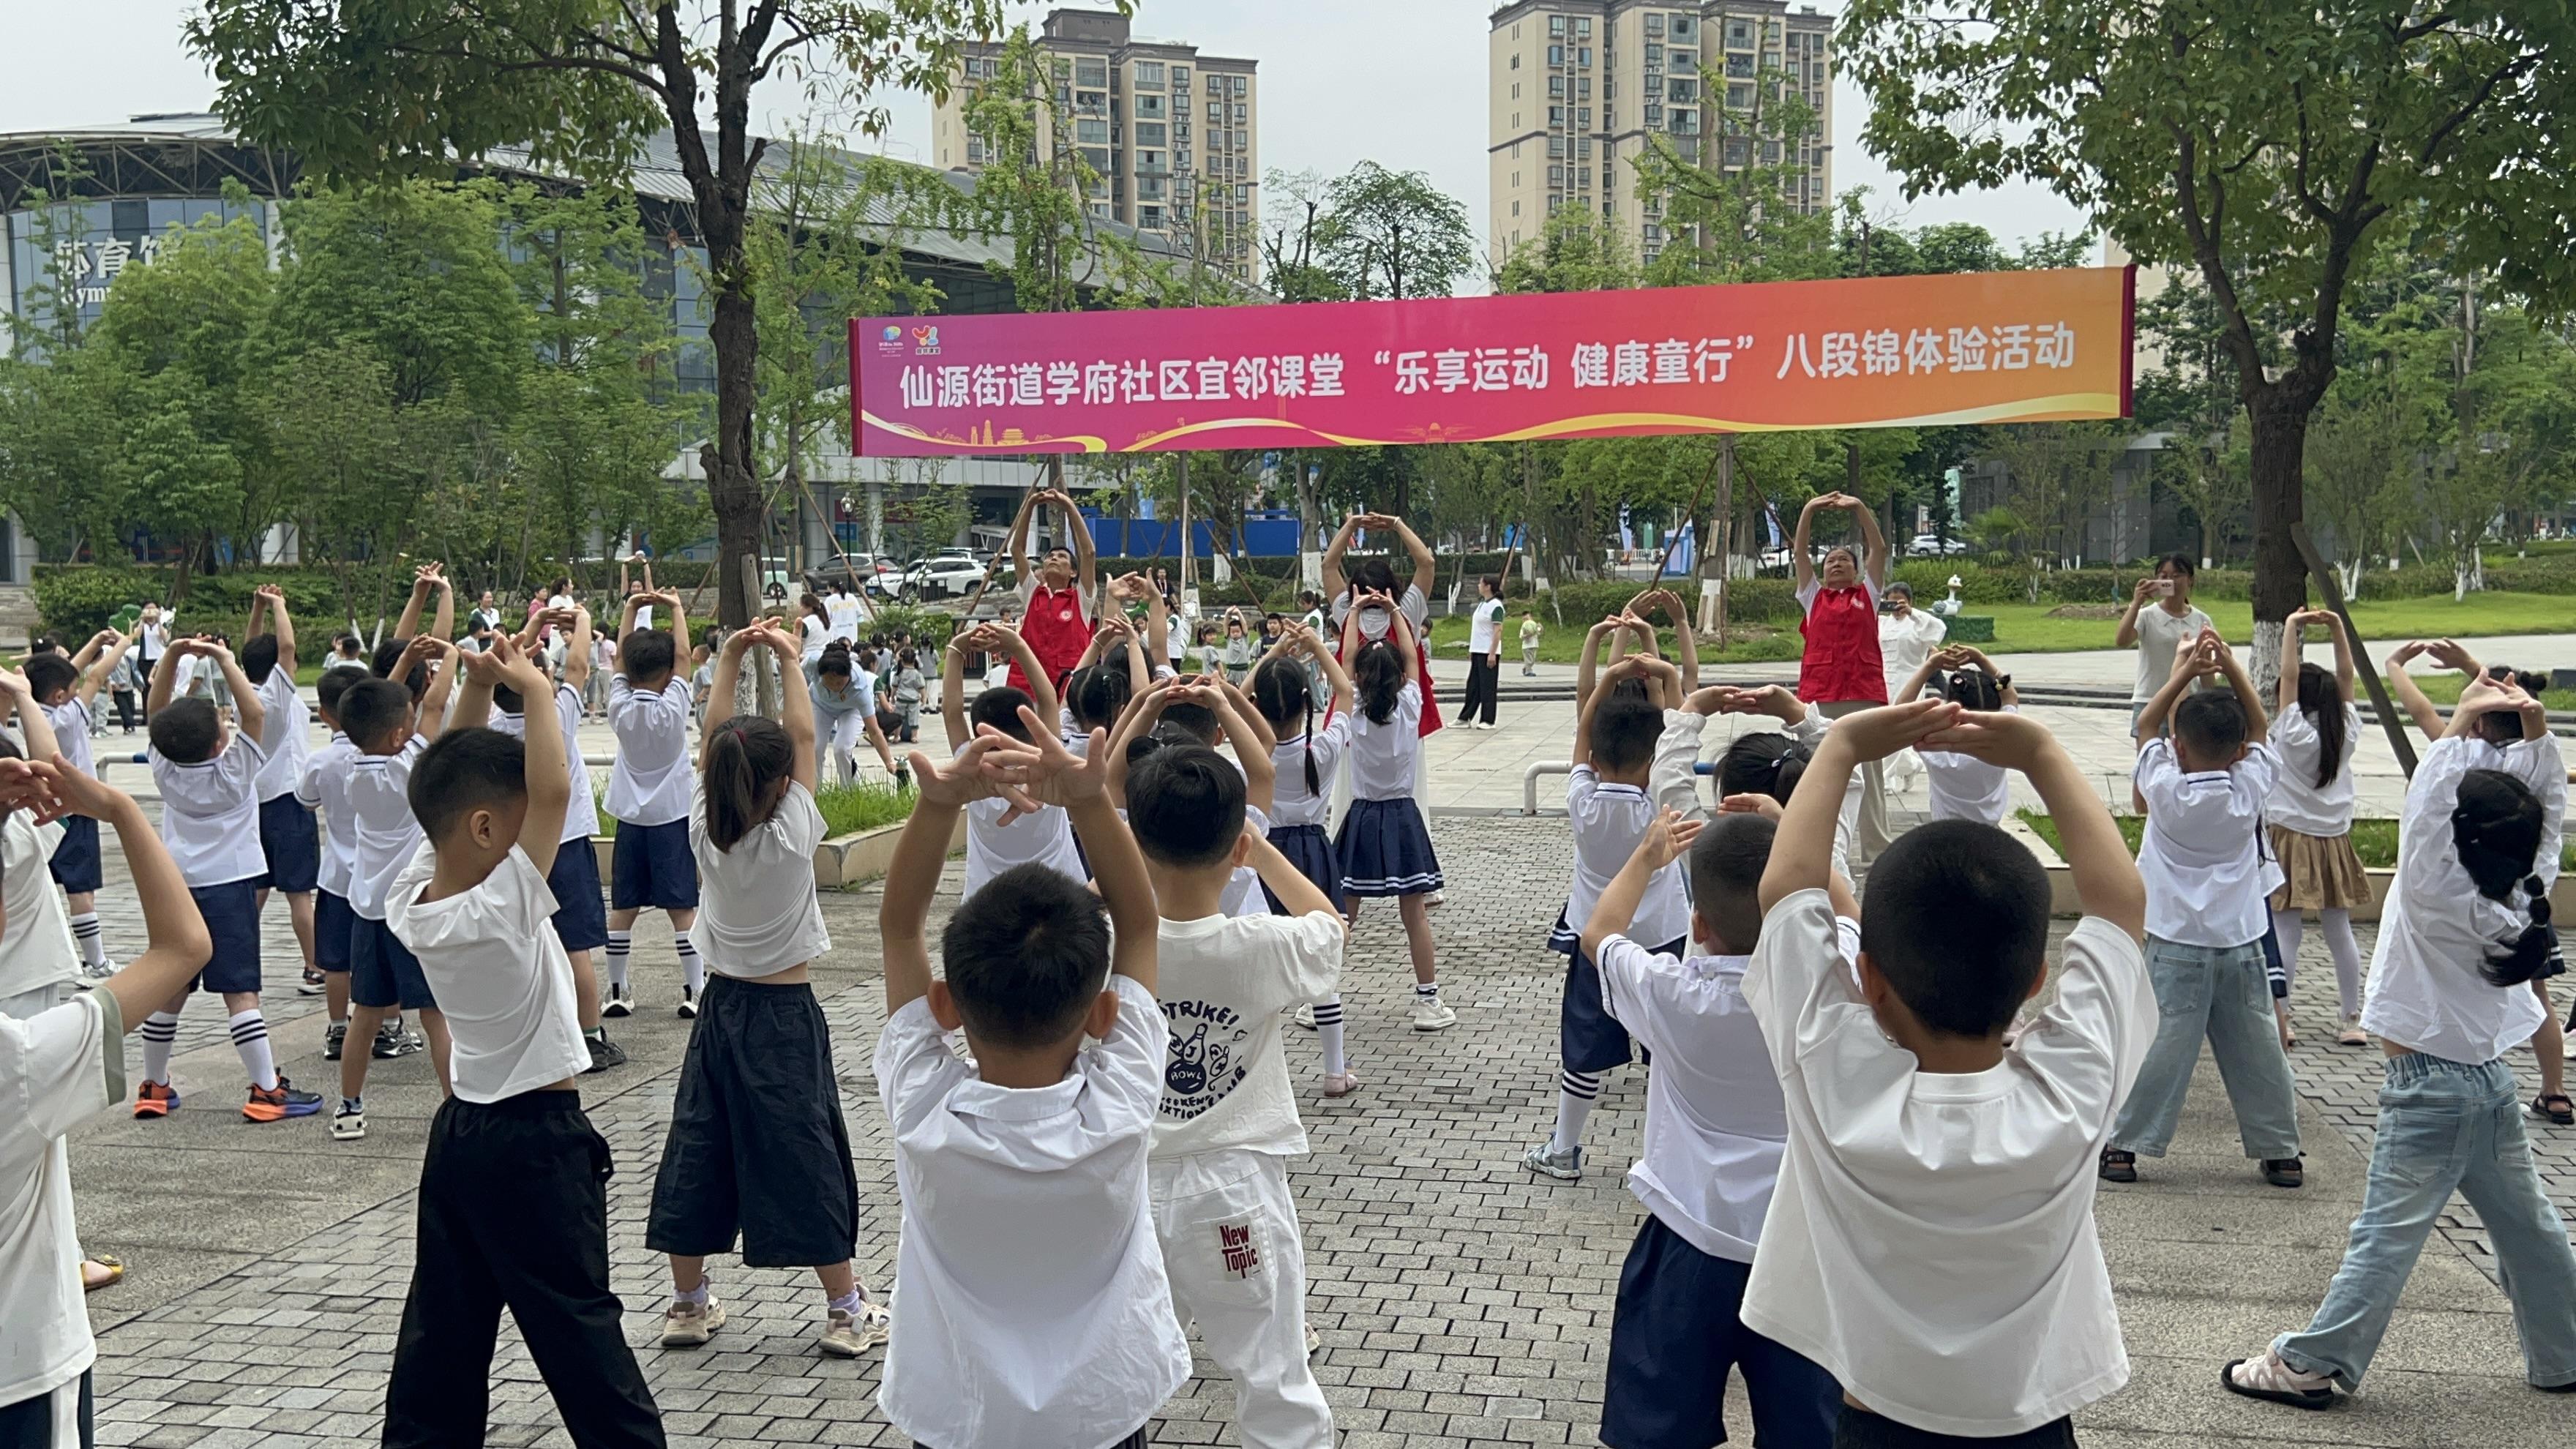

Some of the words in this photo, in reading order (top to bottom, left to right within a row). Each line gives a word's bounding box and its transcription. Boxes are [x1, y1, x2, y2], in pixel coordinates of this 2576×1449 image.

[56, 235, 183, 281] 体育
[899, 352, 1345, 410] 仙源街道学府社区宜邻课堂
[1374, 344, 1549, 394] “乐享运动
[1570, 334, 1754, 389] 健康童行”
[1776, 320, 2075, 380] 八段锦体验活动
[1170, 1070, 1202, 1082] BOWL
[1218, 1224, 1249, 1247] New
[1221, 1244, 1258, 1279] Topic
